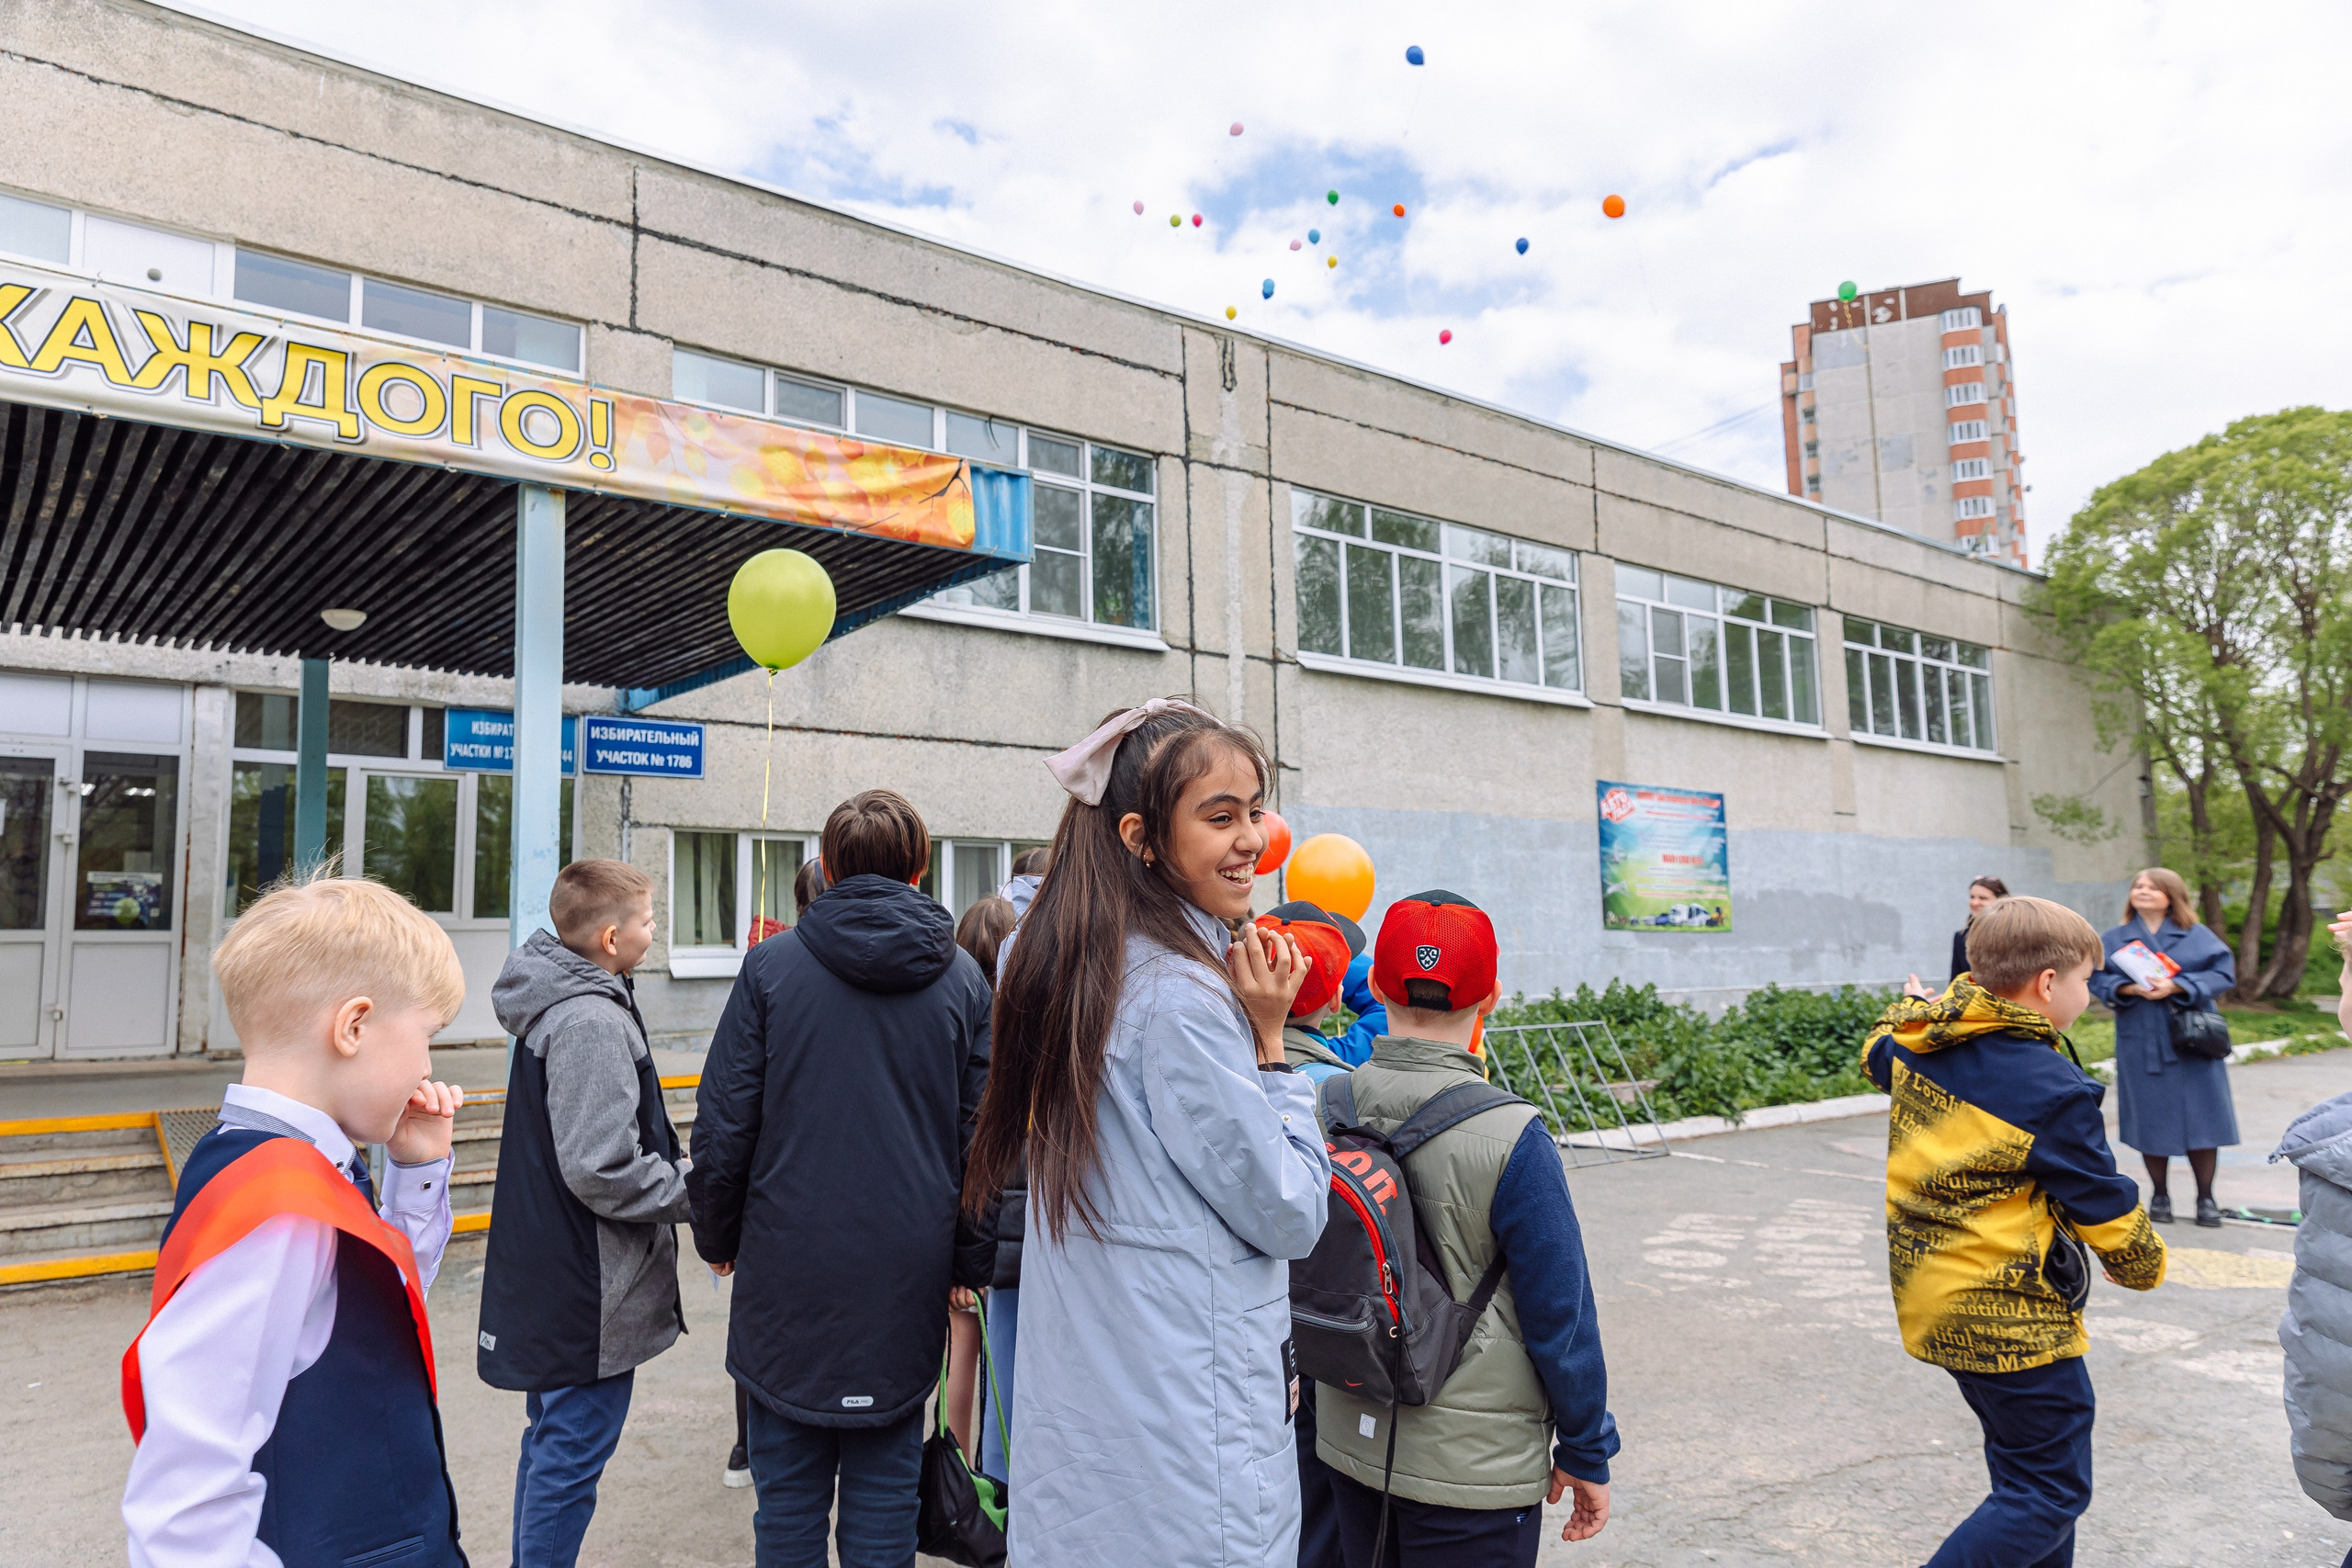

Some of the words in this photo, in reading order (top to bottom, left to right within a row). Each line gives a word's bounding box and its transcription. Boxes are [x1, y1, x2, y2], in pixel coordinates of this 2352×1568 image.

[471, 720, 514, 737] ИЗБИРАТ
[591, 726, 699, 747] ИЗБИРАТЕЛЬНЫЙ
[449, 742, 492, 759] УЧАСТКИ
[596, 749, 650, 766] УЧАСТОК
[650, 753, 664, 767] №
